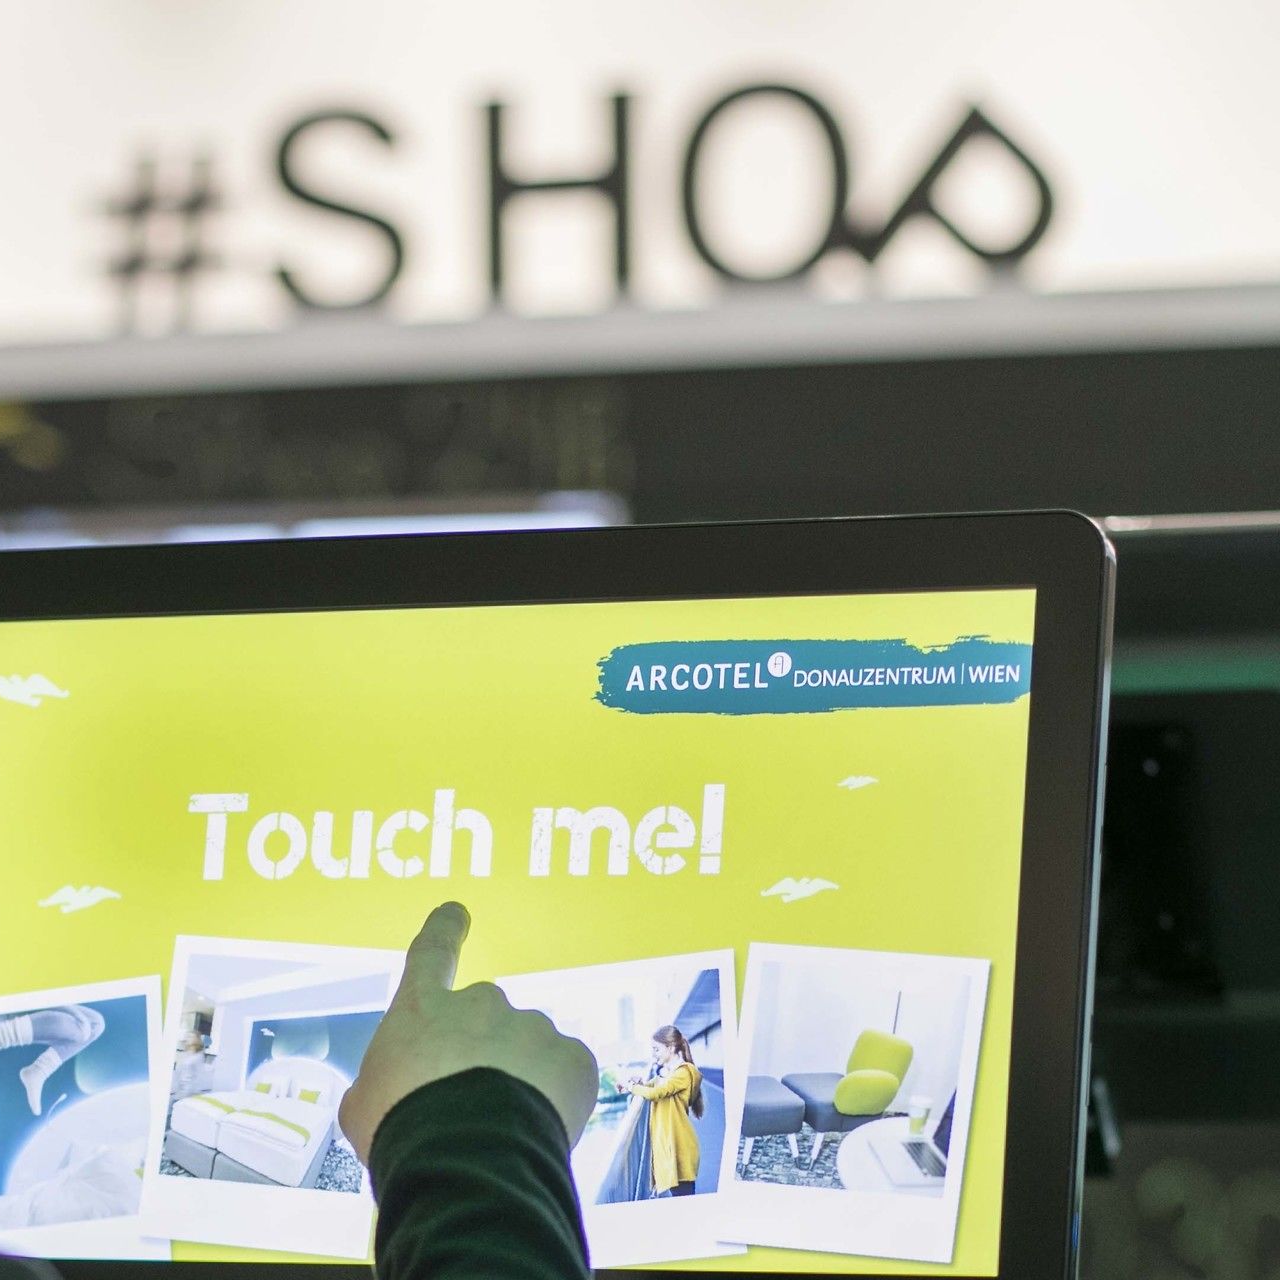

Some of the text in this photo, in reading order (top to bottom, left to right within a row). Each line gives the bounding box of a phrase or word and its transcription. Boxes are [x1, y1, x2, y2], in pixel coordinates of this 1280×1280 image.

[625, 661, 768, 691] ARCOTEL
[793, 666, 956, 688] DONAUZENTRUM
[968, 665, 1020, 683] WIEN
[188, 783, 726, 880] Touch me!
